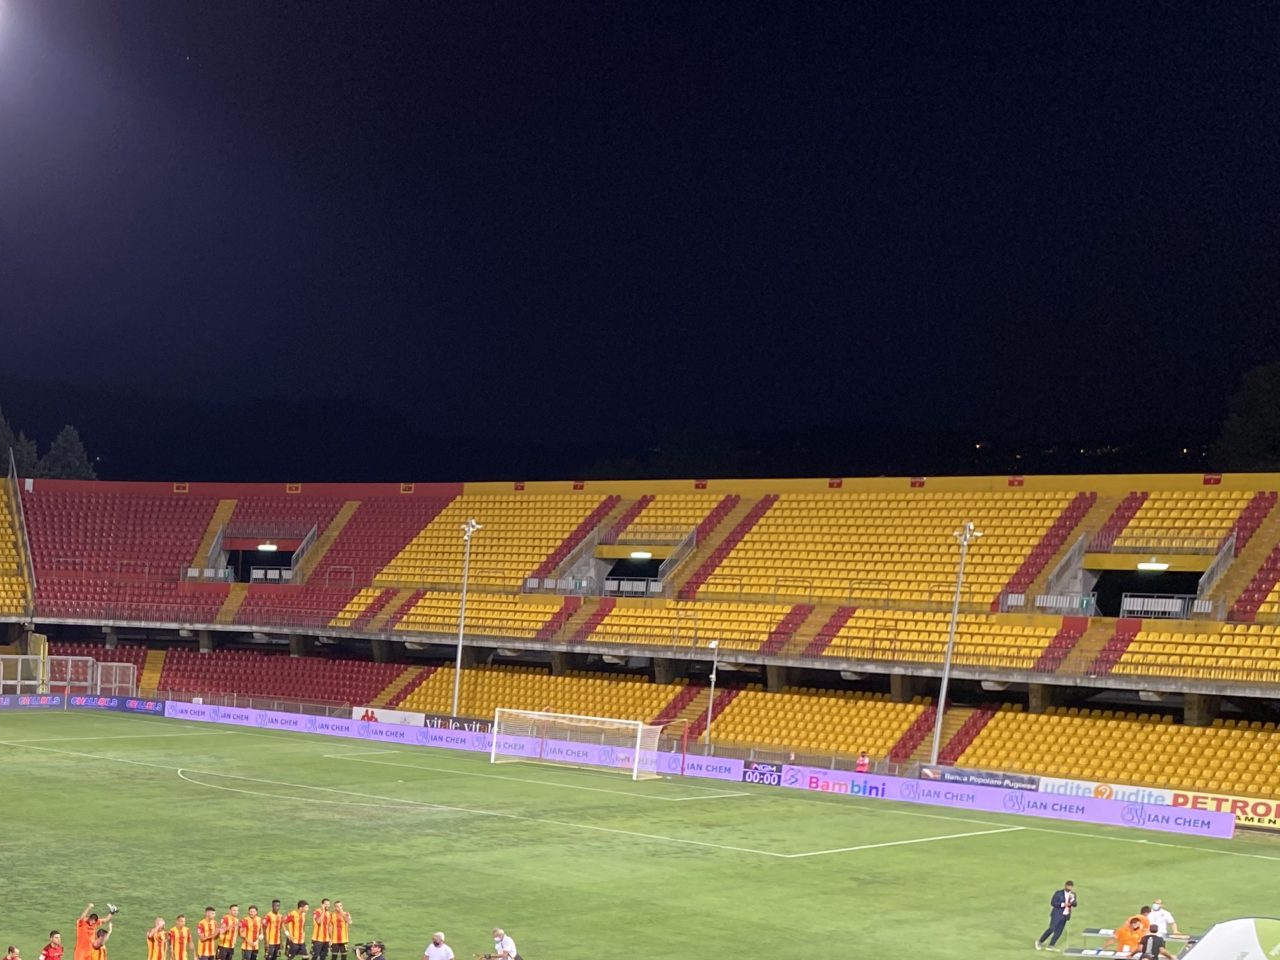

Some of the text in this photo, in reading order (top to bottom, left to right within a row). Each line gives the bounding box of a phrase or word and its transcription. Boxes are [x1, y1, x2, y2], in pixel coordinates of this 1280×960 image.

[426, 716, 460, 730] vitale
[746, 772, 778, 785] 00:00
[808, 776, 886, 798] Bambini
[1114, 789, 1166, 805] udite
